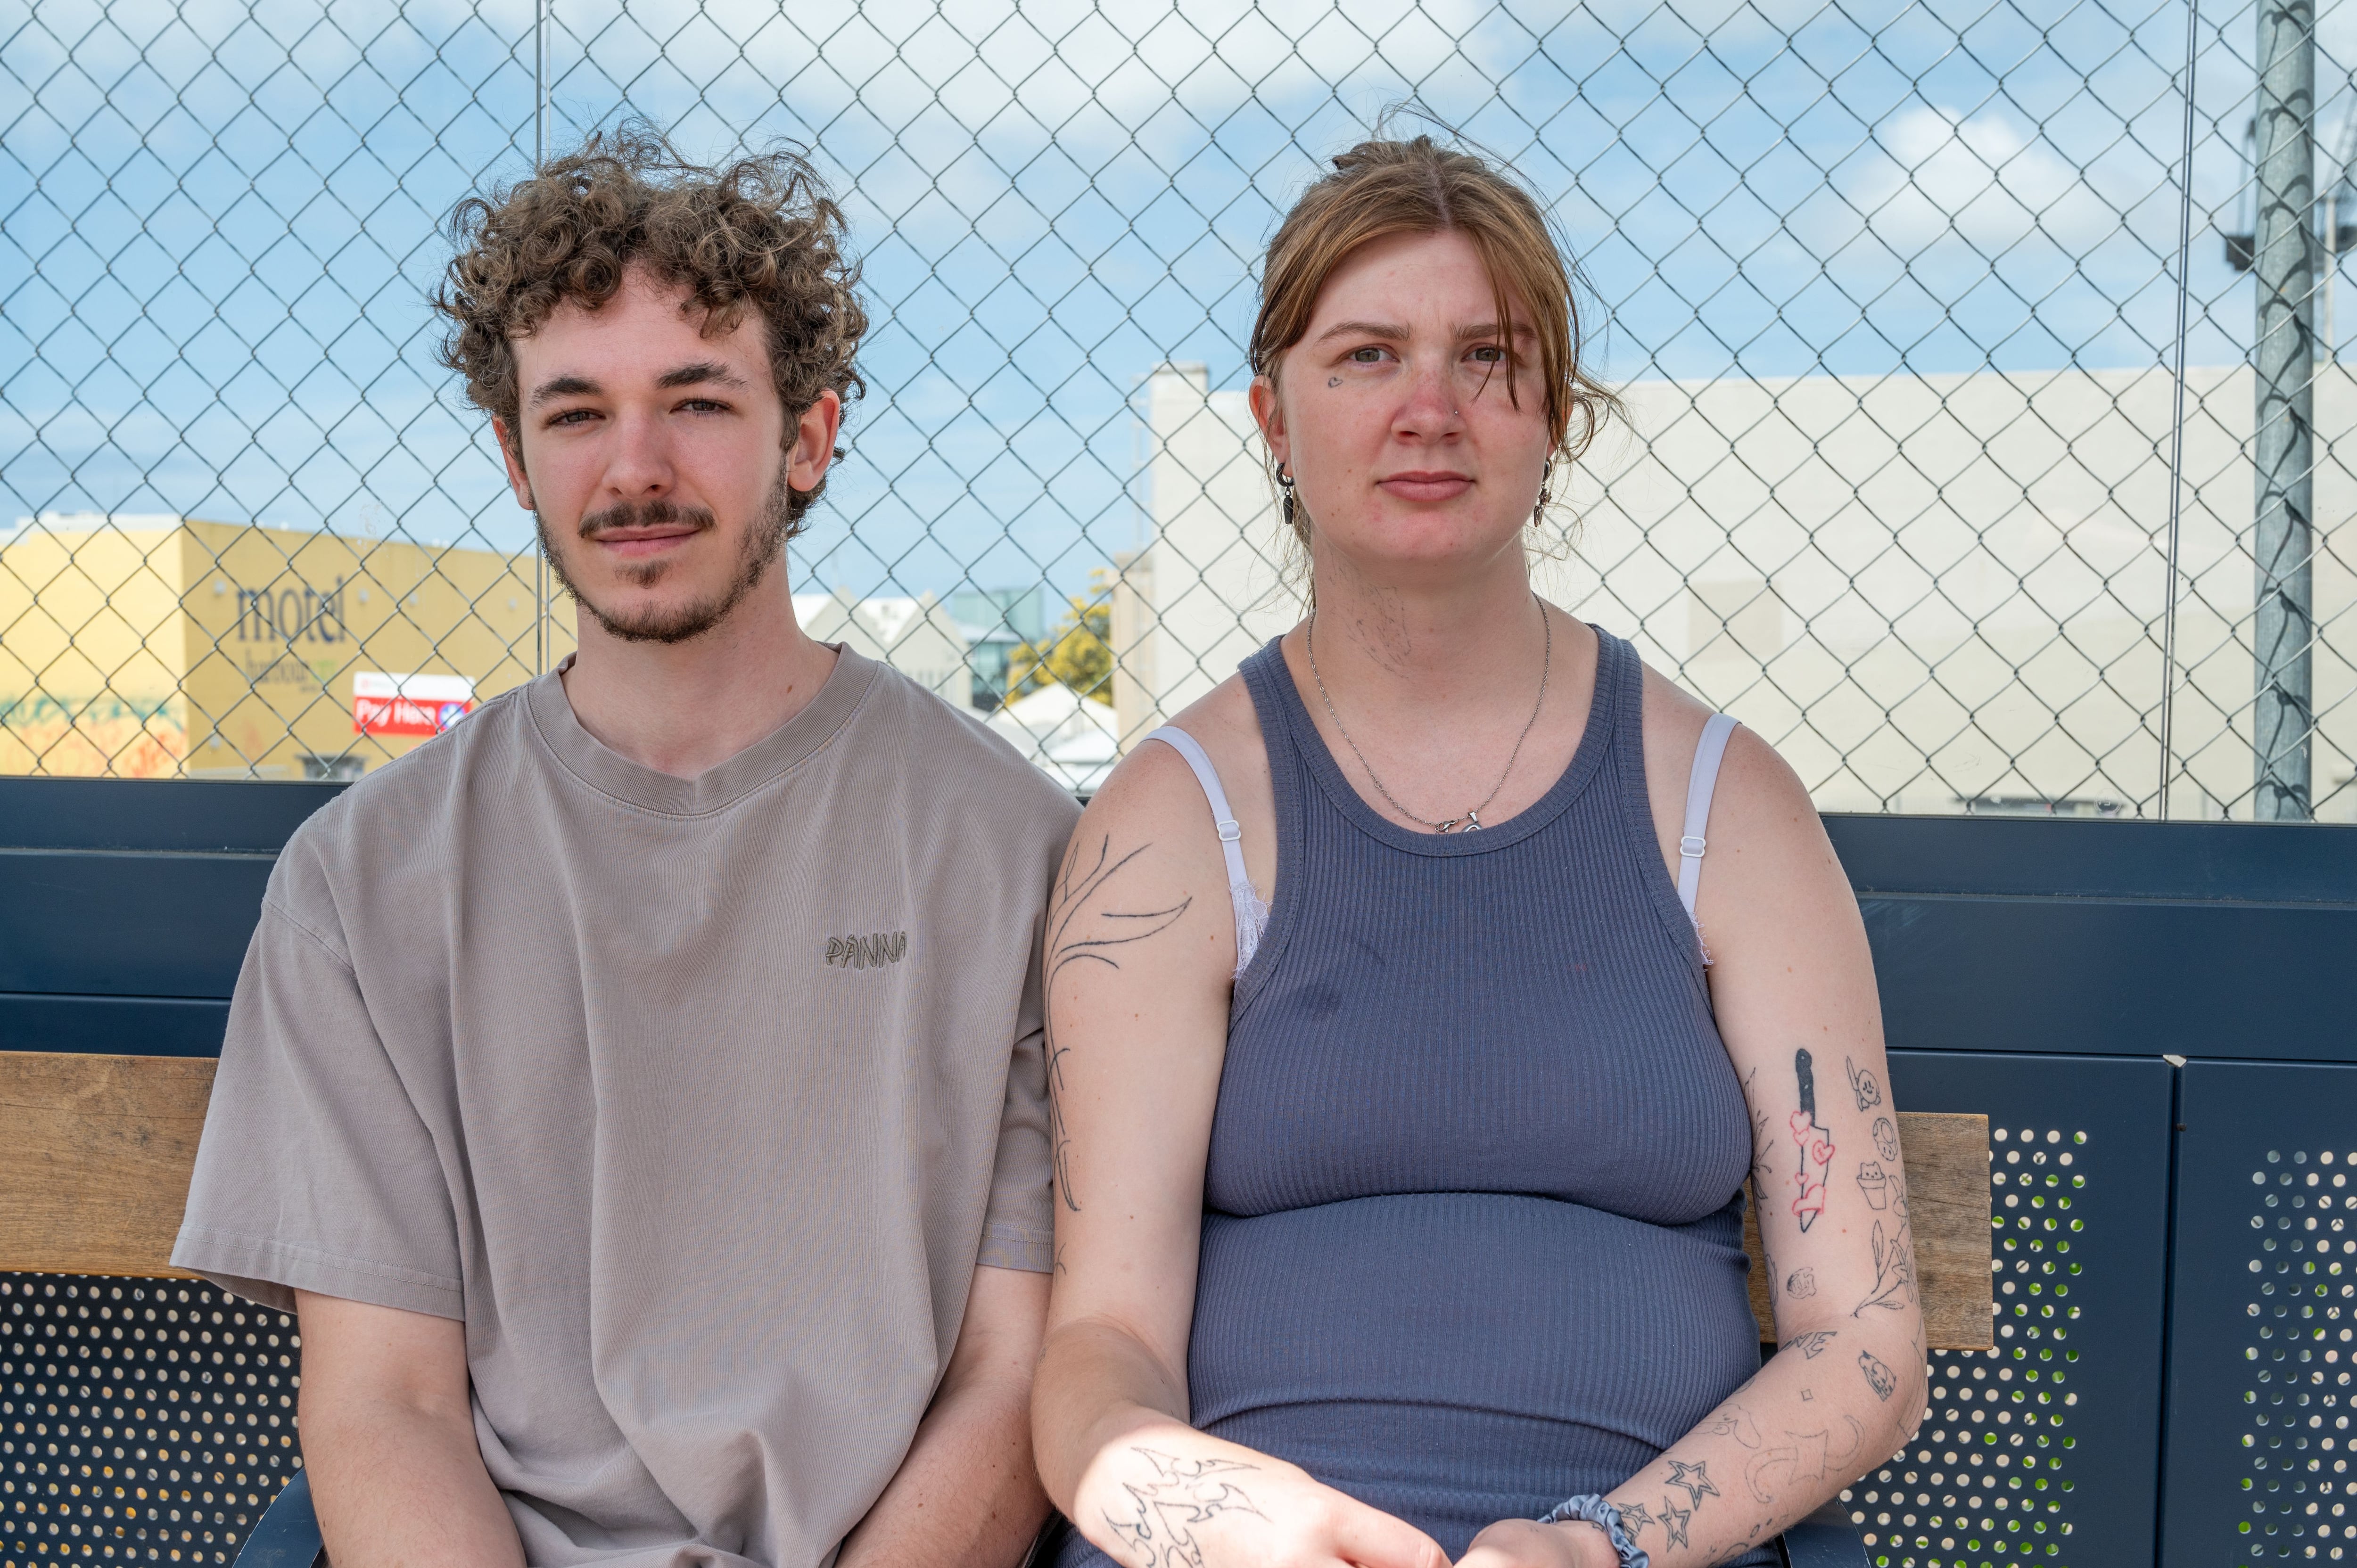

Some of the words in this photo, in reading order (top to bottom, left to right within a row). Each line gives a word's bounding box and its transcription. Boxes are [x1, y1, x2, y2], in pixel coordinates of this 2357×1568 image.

[236, 575, 345, 644] motel
[356, 699, 392, 727] Pay
[393, 700, 436, 725] Here
